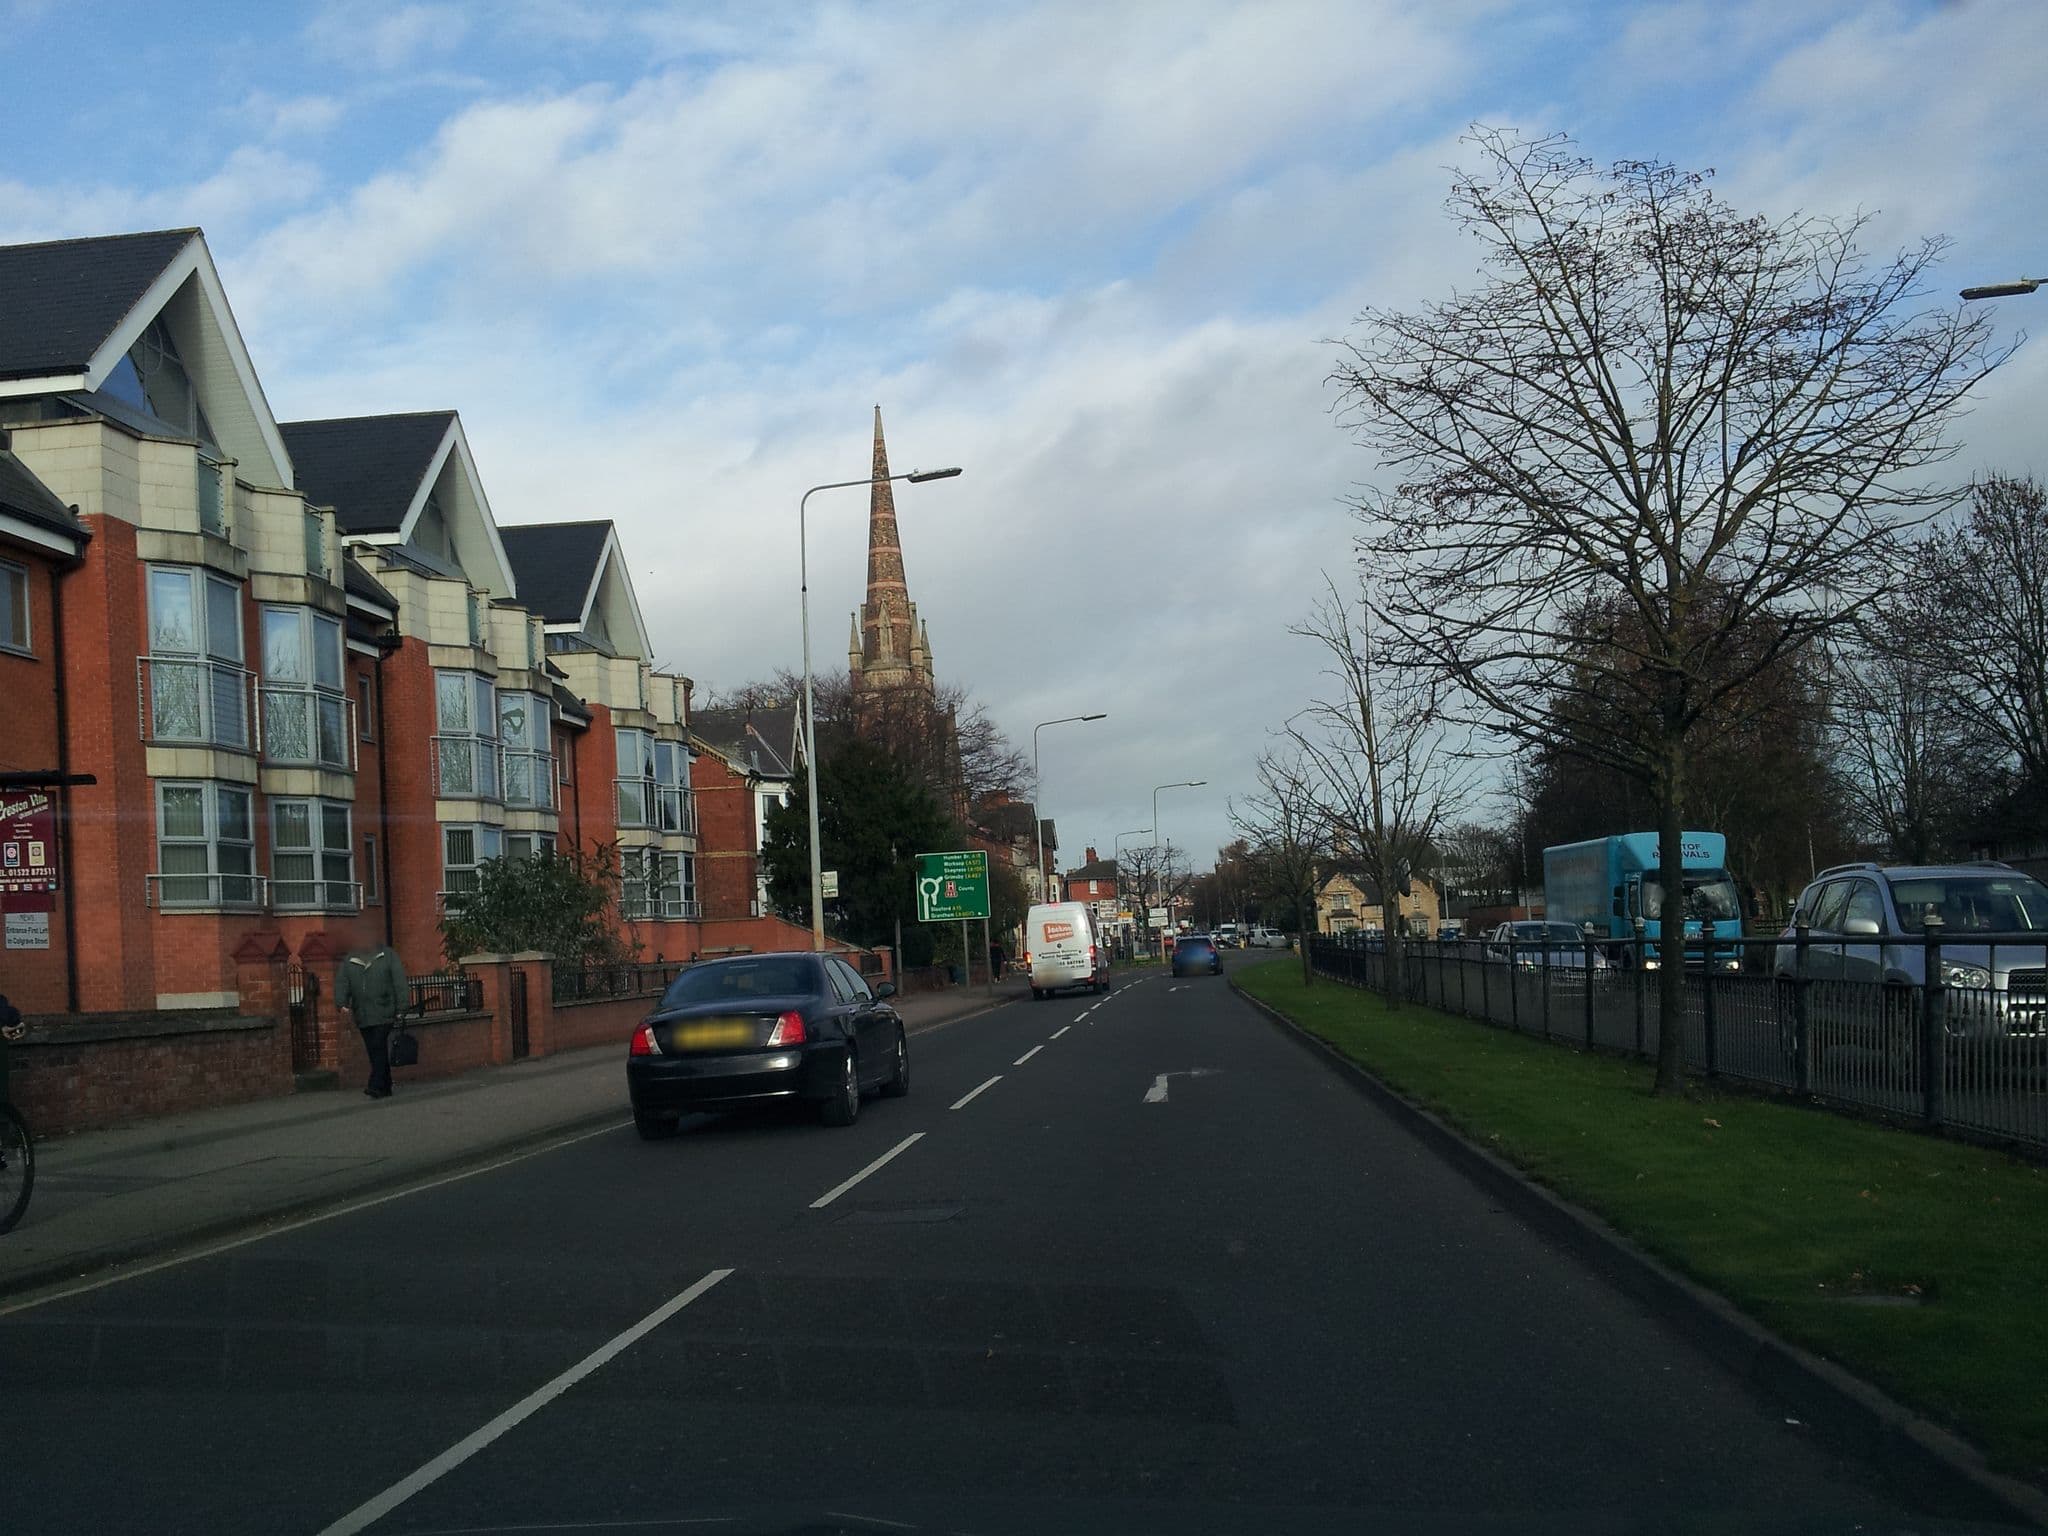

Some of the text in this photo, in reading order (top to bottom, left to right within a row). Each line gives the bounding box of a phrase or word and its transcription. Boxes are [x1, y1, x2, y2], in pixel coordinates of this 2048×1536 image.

[29, 794, 48, 806] Villa
[8, 868, 29, 877] 01522
[31, 867, 56, 876] 872511
